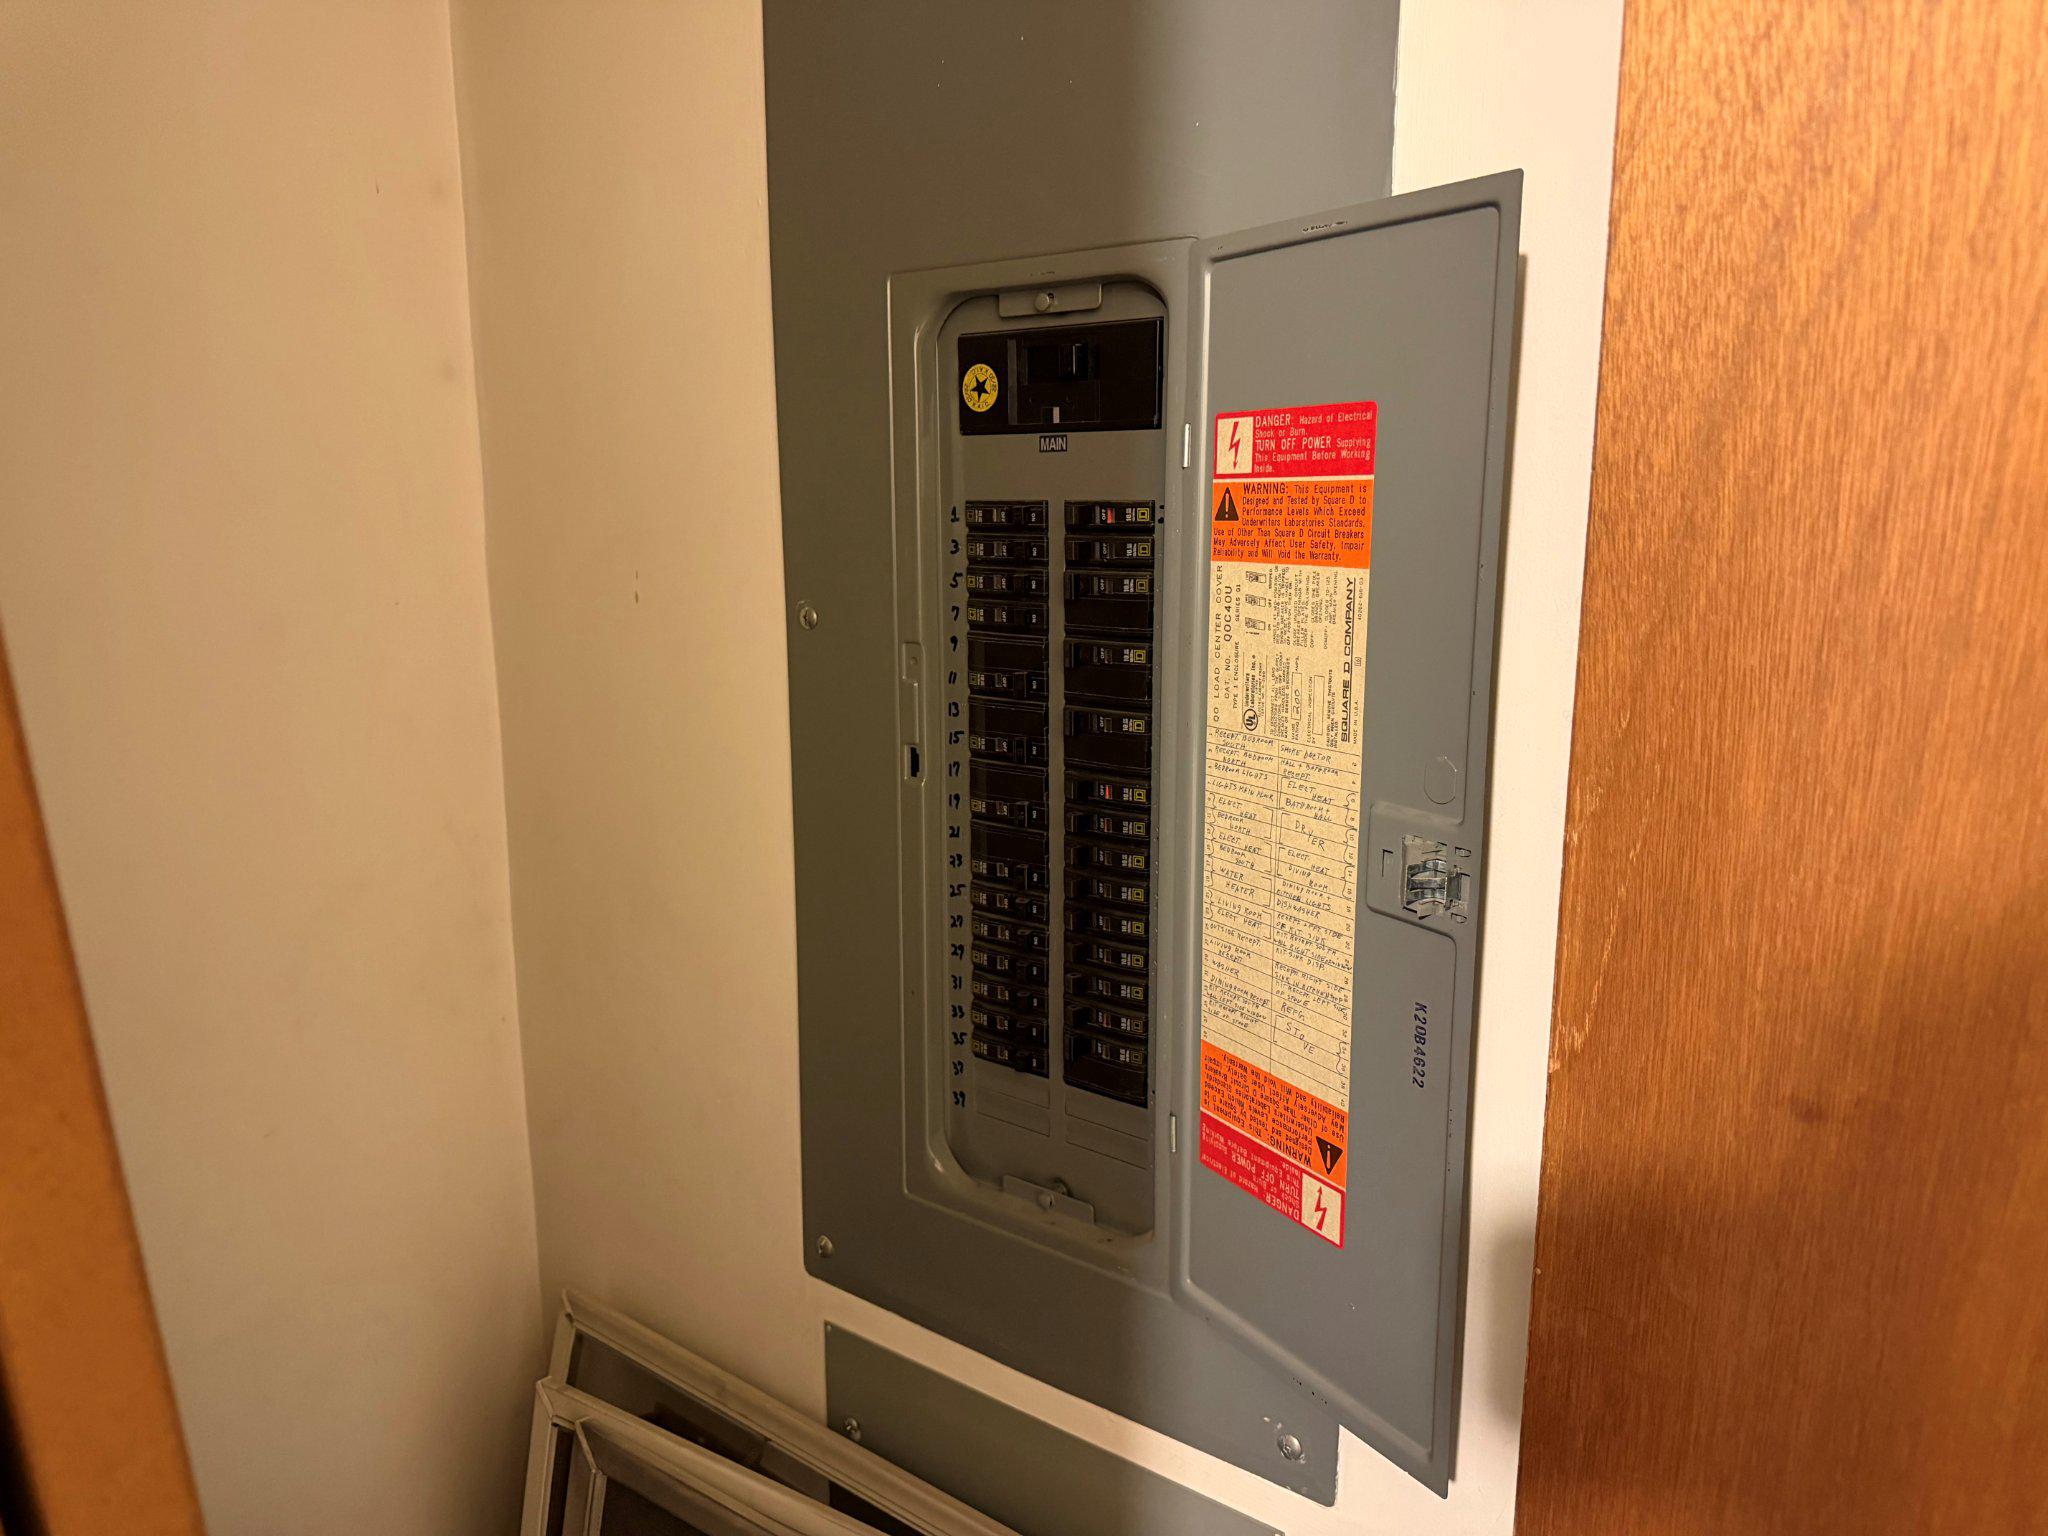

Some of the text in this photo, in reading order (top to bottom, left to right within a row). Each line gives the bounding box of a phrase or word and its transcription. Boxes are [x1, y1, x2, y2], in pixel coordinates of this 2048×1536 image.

[1256, 414, 1294, 427] DANGER:
[1300, 416, 1322, 424] Hazard
[1338, 411, 1372, 422] Electrical
[1255, 429, 1274, 438] Shock
[1040, 436, 1067, 451] MAIN
[1256, 436, 1371, 451] TURN OFF POWER Supplying
[1255, 449, 1370, 463] This Equipment Before Working
[1255, 465, 1274, 473] Inside.
[1243, 483, 1366, 495] WARNING: This Equipment is
[1243, 497, 1269, 507] Designed
[1287, 496, 1308, 504] Tested
[1312, 496, 1319, 506] by
[1324, 496, 1345, 506] Square
[1350, 495, 1354, 504] D
[1360, 496, 1366, 504] to
[951, 506, 959, 522] 1
[1242, 507, 1365, 516] Performance Levels Which Exceed
[1242, 518, 1365, 527] Underwriters Laboratories Standards.
[1214, 528, 1364, 539] Use of Other Than Square D Circuit Breakers
[950, 539, 959, 554] 3
[1214, 537, 1225, 547] May
[1230, 538, 1260, 548] Adversely
[1265, 539, 1286, 548] Affect
[1289, 540, 1305, 548] User
[1342, 541, 1364, 550] Impair
[1214, 548, 1341, 561] Reliability and Will Void the Warranty.
[950, 573, 963, 588] 5
[951, 606, 959, 621] 7
[950, 635, 958, 652] 9
[1341, 577, 1353, 742] SQUARE D COMPANY
[949, 702, 960, 717] 13
[1292, 690, 1300, 714] 200
[949, 731, 964, 745] 15
[949, 761, 960, 777] 17
[949, 793, 960, 809] 19
[949, 826, 960, 837] 21
[950, 854, 963, 868] 23
[950, 884, 966, 897] 25
[951, 915, 963, 929] 27
[951, 944, 964, 960] 29
[951, 975, 962, 990] 31
[952, 1005, 965, 1019] 33
[952, 1032, 968, 1045] 35
[1412, 1001, 1428, 1089] K20B4622
[953, 1061, 964, 1076] 37
[953, 1091, 965, 1107] 39
[1268, 1133, 1312, 1167] WARNING:
[1231, 1155, 1299, 1200] TURN OFF POWER
